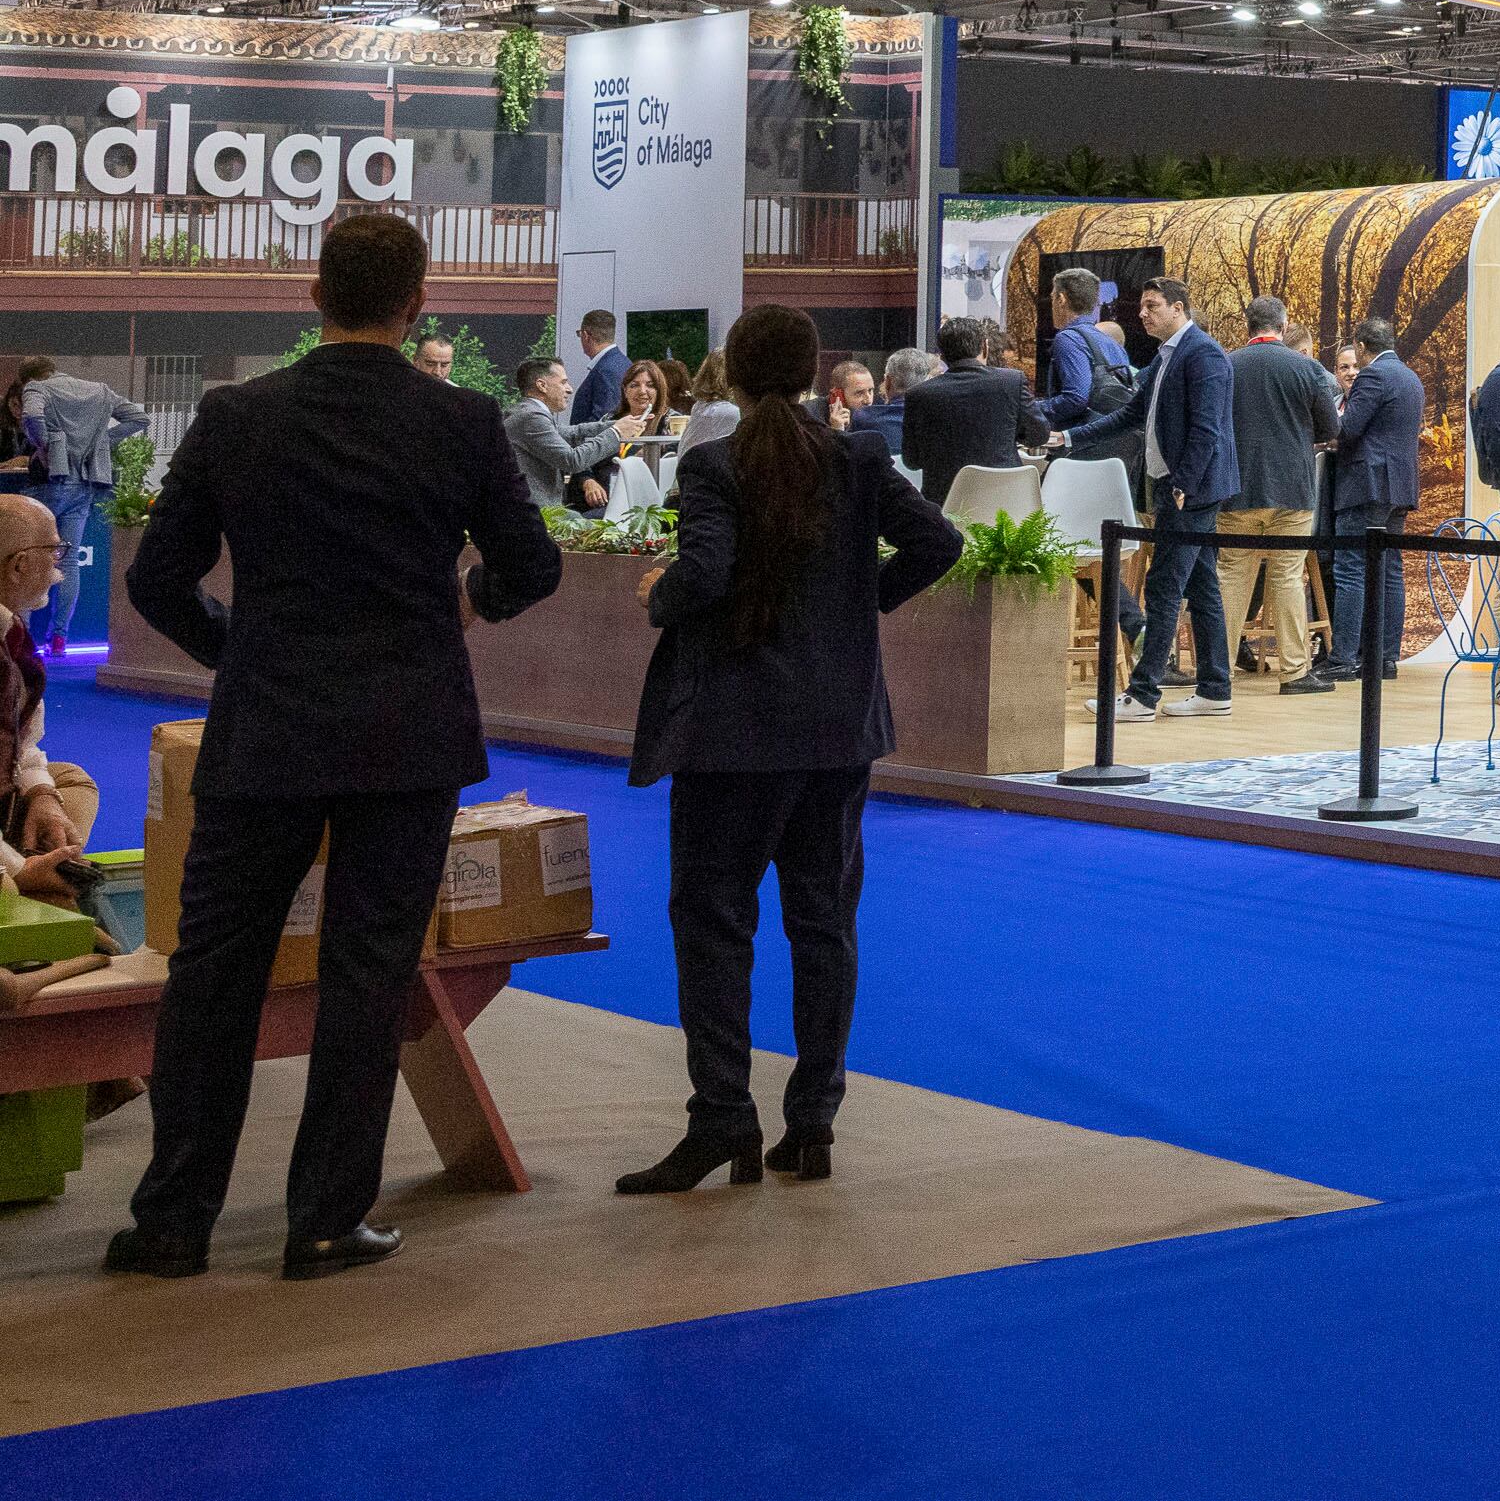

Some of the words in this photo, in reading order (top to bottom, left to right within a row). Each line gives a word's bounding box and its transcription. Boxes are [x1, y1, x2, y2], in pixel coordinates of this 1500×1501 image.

[638, 95, 670, 130] City
[637, 135, 653, 166] of
[656, 133, 712, 168] Málaga
